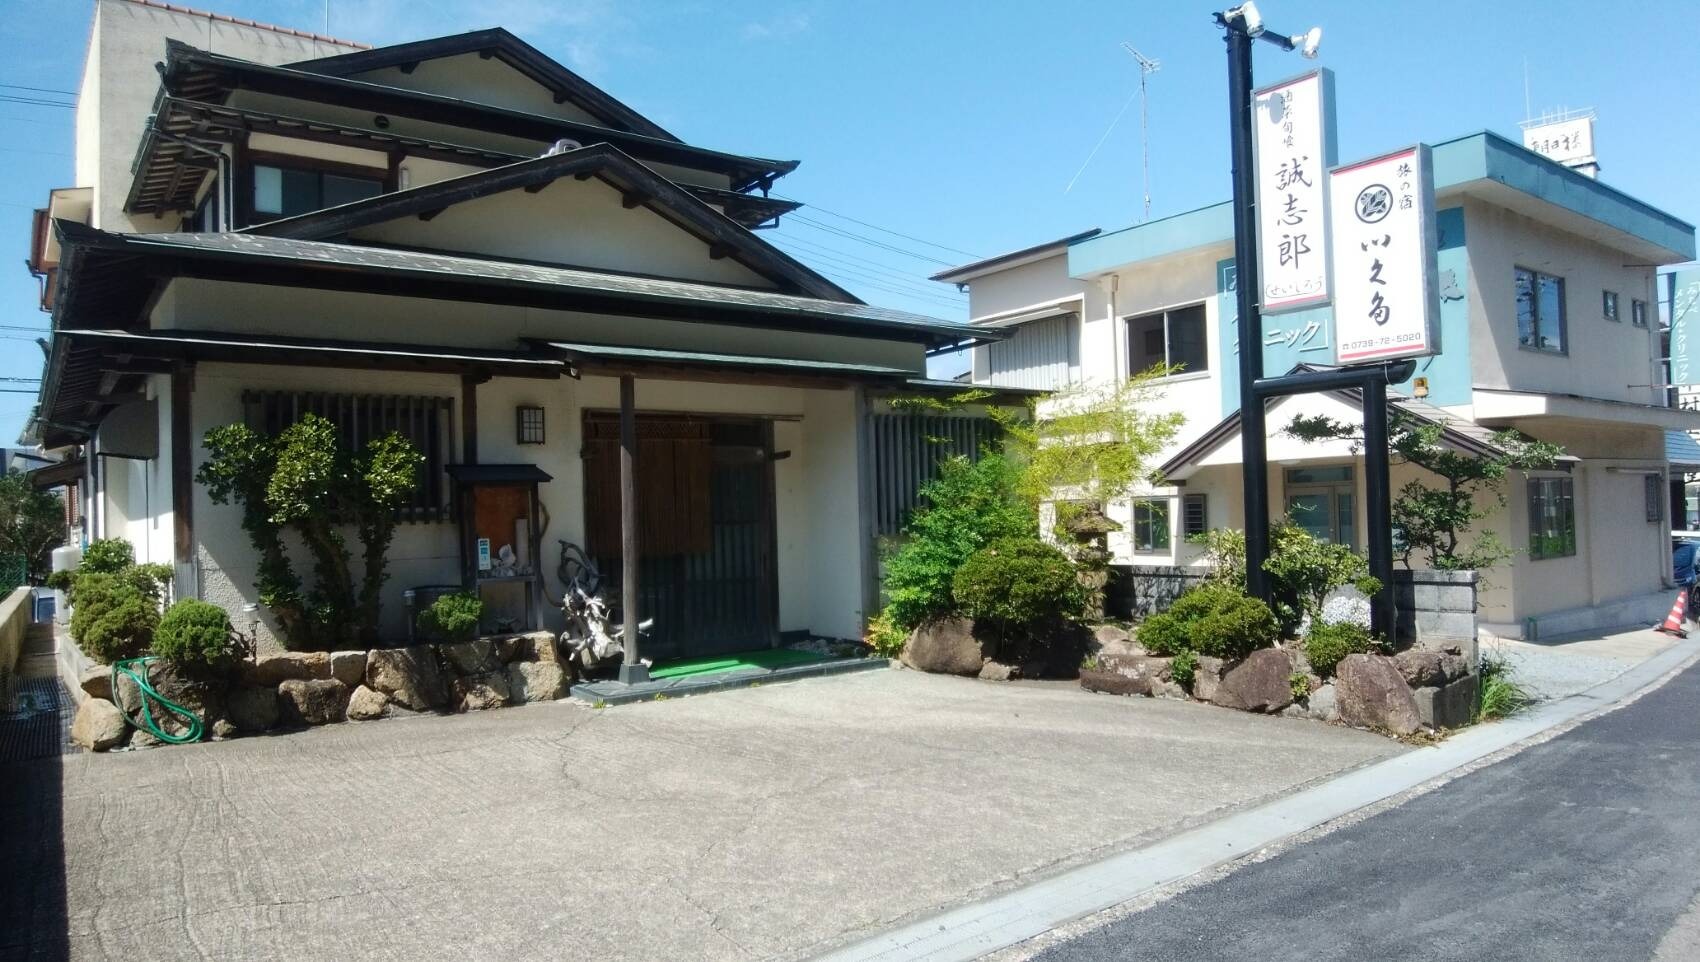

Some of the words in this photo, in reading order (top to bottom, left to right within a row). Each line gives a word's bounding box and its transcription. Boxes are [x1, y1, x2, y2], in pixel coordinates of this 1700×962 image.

[1396, 162, 1413, 210] 旅の宿
[1274, 155, 1312, 269] 誠志郎
[1351, 332, 1421, 349] 0739-72-5020
